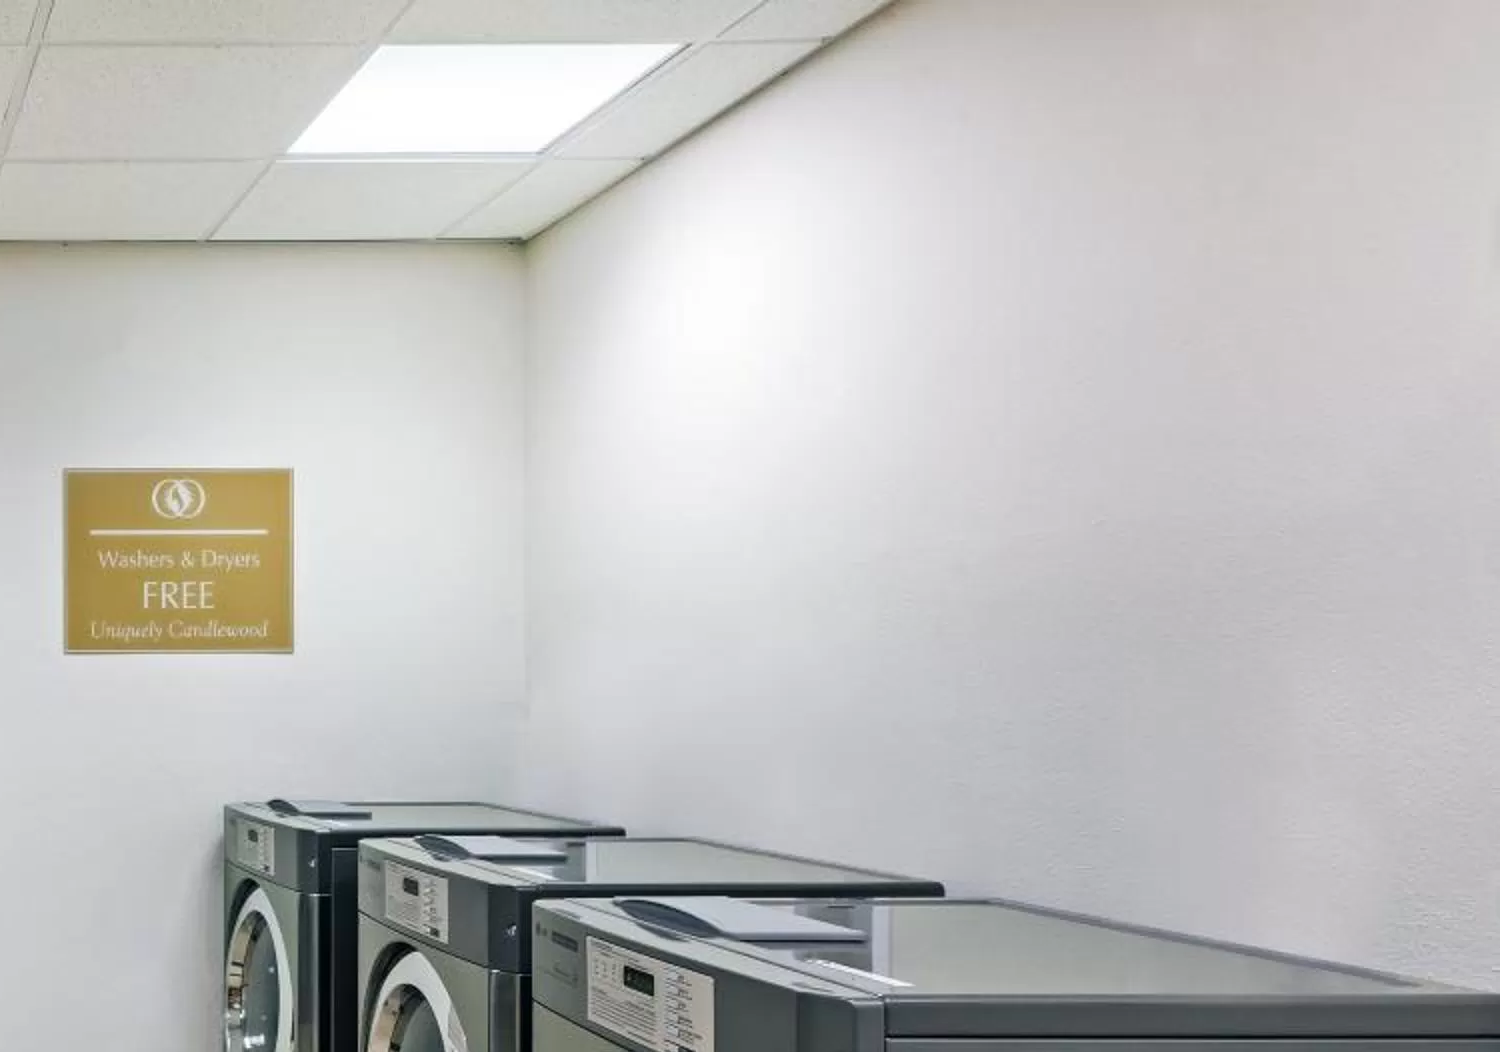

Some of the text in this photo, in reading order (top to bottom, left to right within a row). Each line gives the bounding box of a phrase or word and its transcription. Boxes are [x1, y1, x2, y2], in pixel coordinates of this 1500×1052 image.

[98, 550, 261, 572] Washers & Dryers
[143, 581, 215, 609] FREE
[91, 619, 269, 643] Uniquely Candlewood
